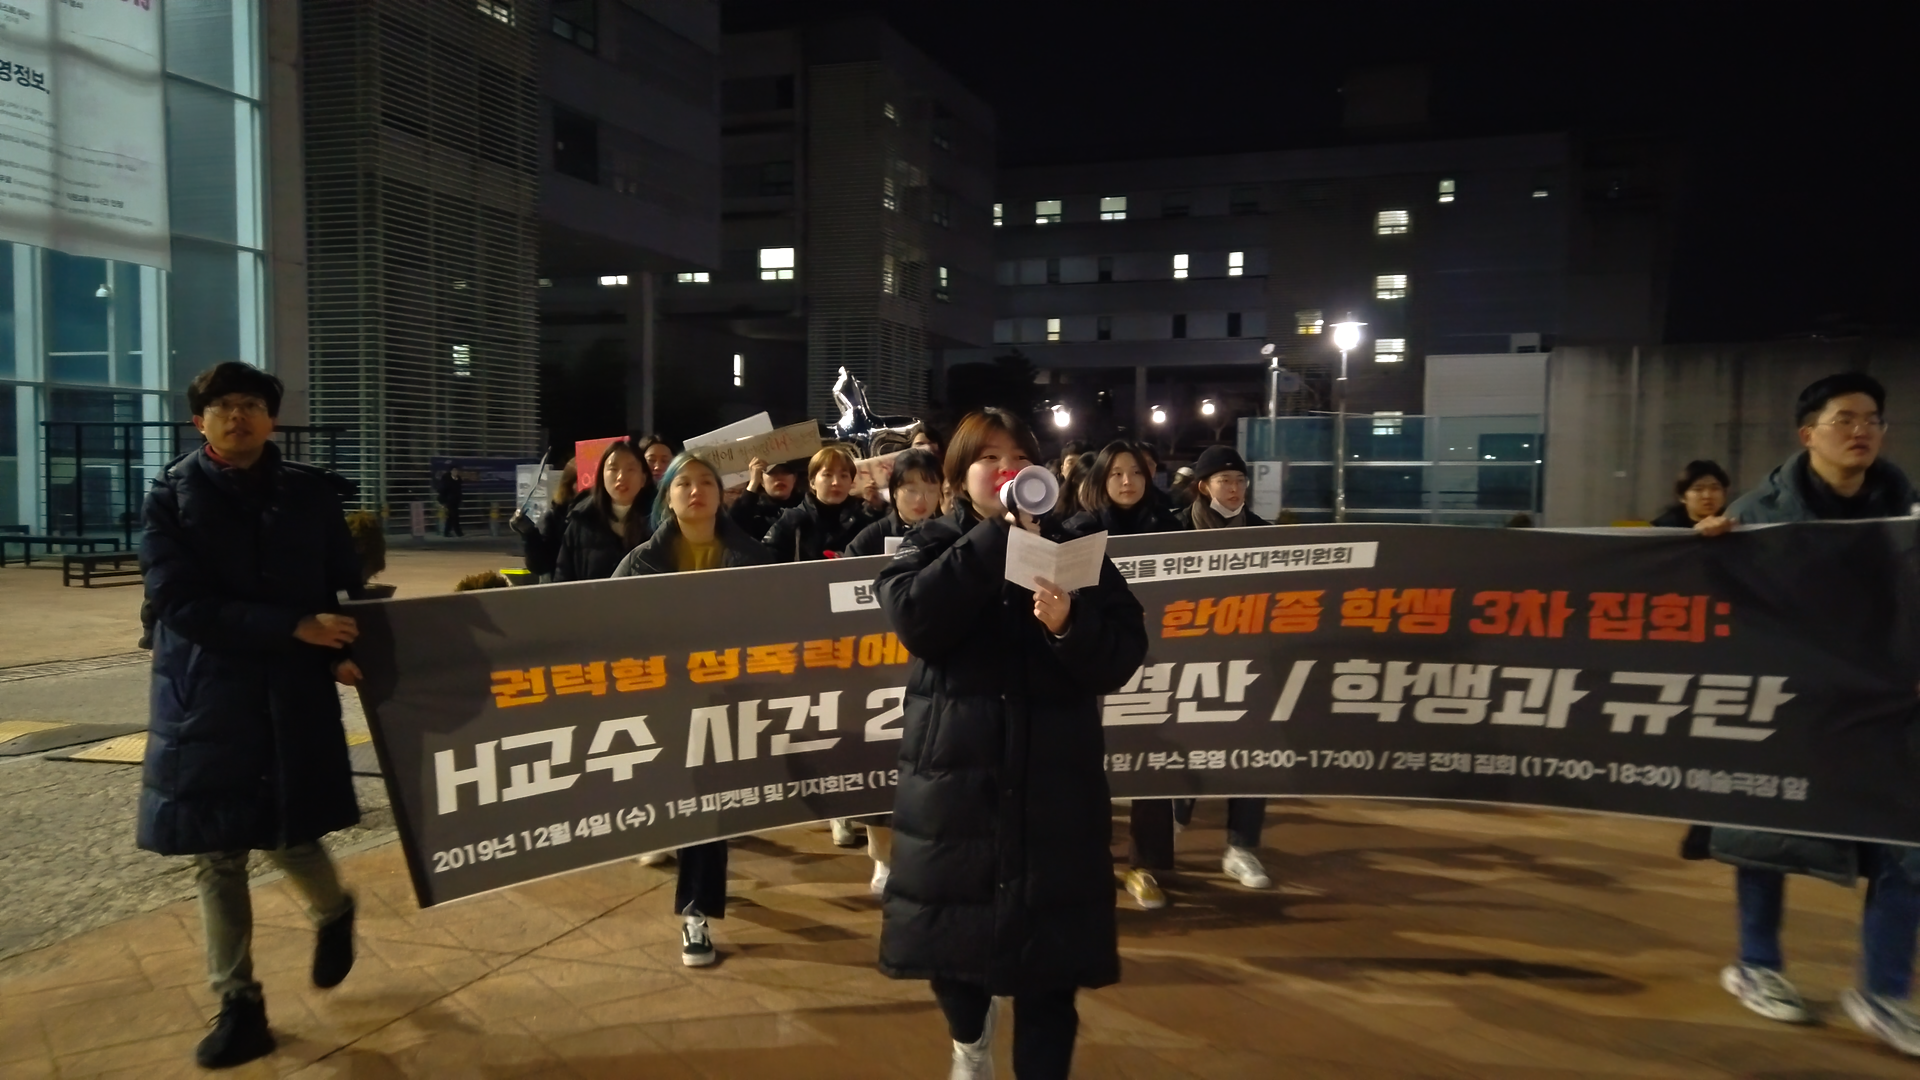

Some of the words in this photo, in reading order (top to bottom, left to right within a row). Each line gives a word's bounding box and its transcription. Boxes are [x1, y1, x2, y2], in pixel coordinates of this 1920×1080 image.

[1258, 465, 1270, 481] P
[1115, 560, 1158, 579] 절을
[1162, 556, 1203, 575] 위한
[1208, 546, 1354, 572] 비상대책위원회
[490, 655, 667, 708] 권력형
[687, 631, 908, 684] 성폭력에
[1161, 590, 1326, 638] 한예종
[1341, 587, 1456, 634] 학생
[1468, 589, 1576, 638] 3차
[1588, 592, 1731, 643] 집회:
[434, 714, 664, 815] H교수
[685, 690, 843, 767] 사건
[1102, 659, 1261, 726] 결산
[1270, 660, 1318, 722] /
[1331, 659, 1591, 729] 학생과
[1602, 671, 1797, 742] 규탄
[433, 836, 516, 874] 2019년
[520, 820, 572, 852] 12월
[575, 812, 612, 839] 4일
[616, 803, 656, 832] (수)
[666, 796, 698, 820] 1부
[701, 789, 760, 814] 피켓팅
[764, 784, 784, 803] 및
[788, 772, 865, 799] 기자회견
[1111, 753, 1133, 772] 앞
[1134, 752, 1144, 771] /
[1147, 751, 1186, 770] 부스
[1188, 750, 1226, 770] 운영
[1230, 749, 1375, 770] (13:00-17:00)
[1378, 750, 1390, 771] /
[1392, 750, 1427, 772] 2부
[1429, 752, 1472, 773] 전체
[1474, 753, 1516, 776] 집회
[1520, 757, 1682, 790] (17:00-18:30)
[1685, 768, 1779, 798] 예술극장
[1781, 776, 1809, 801] 앞
